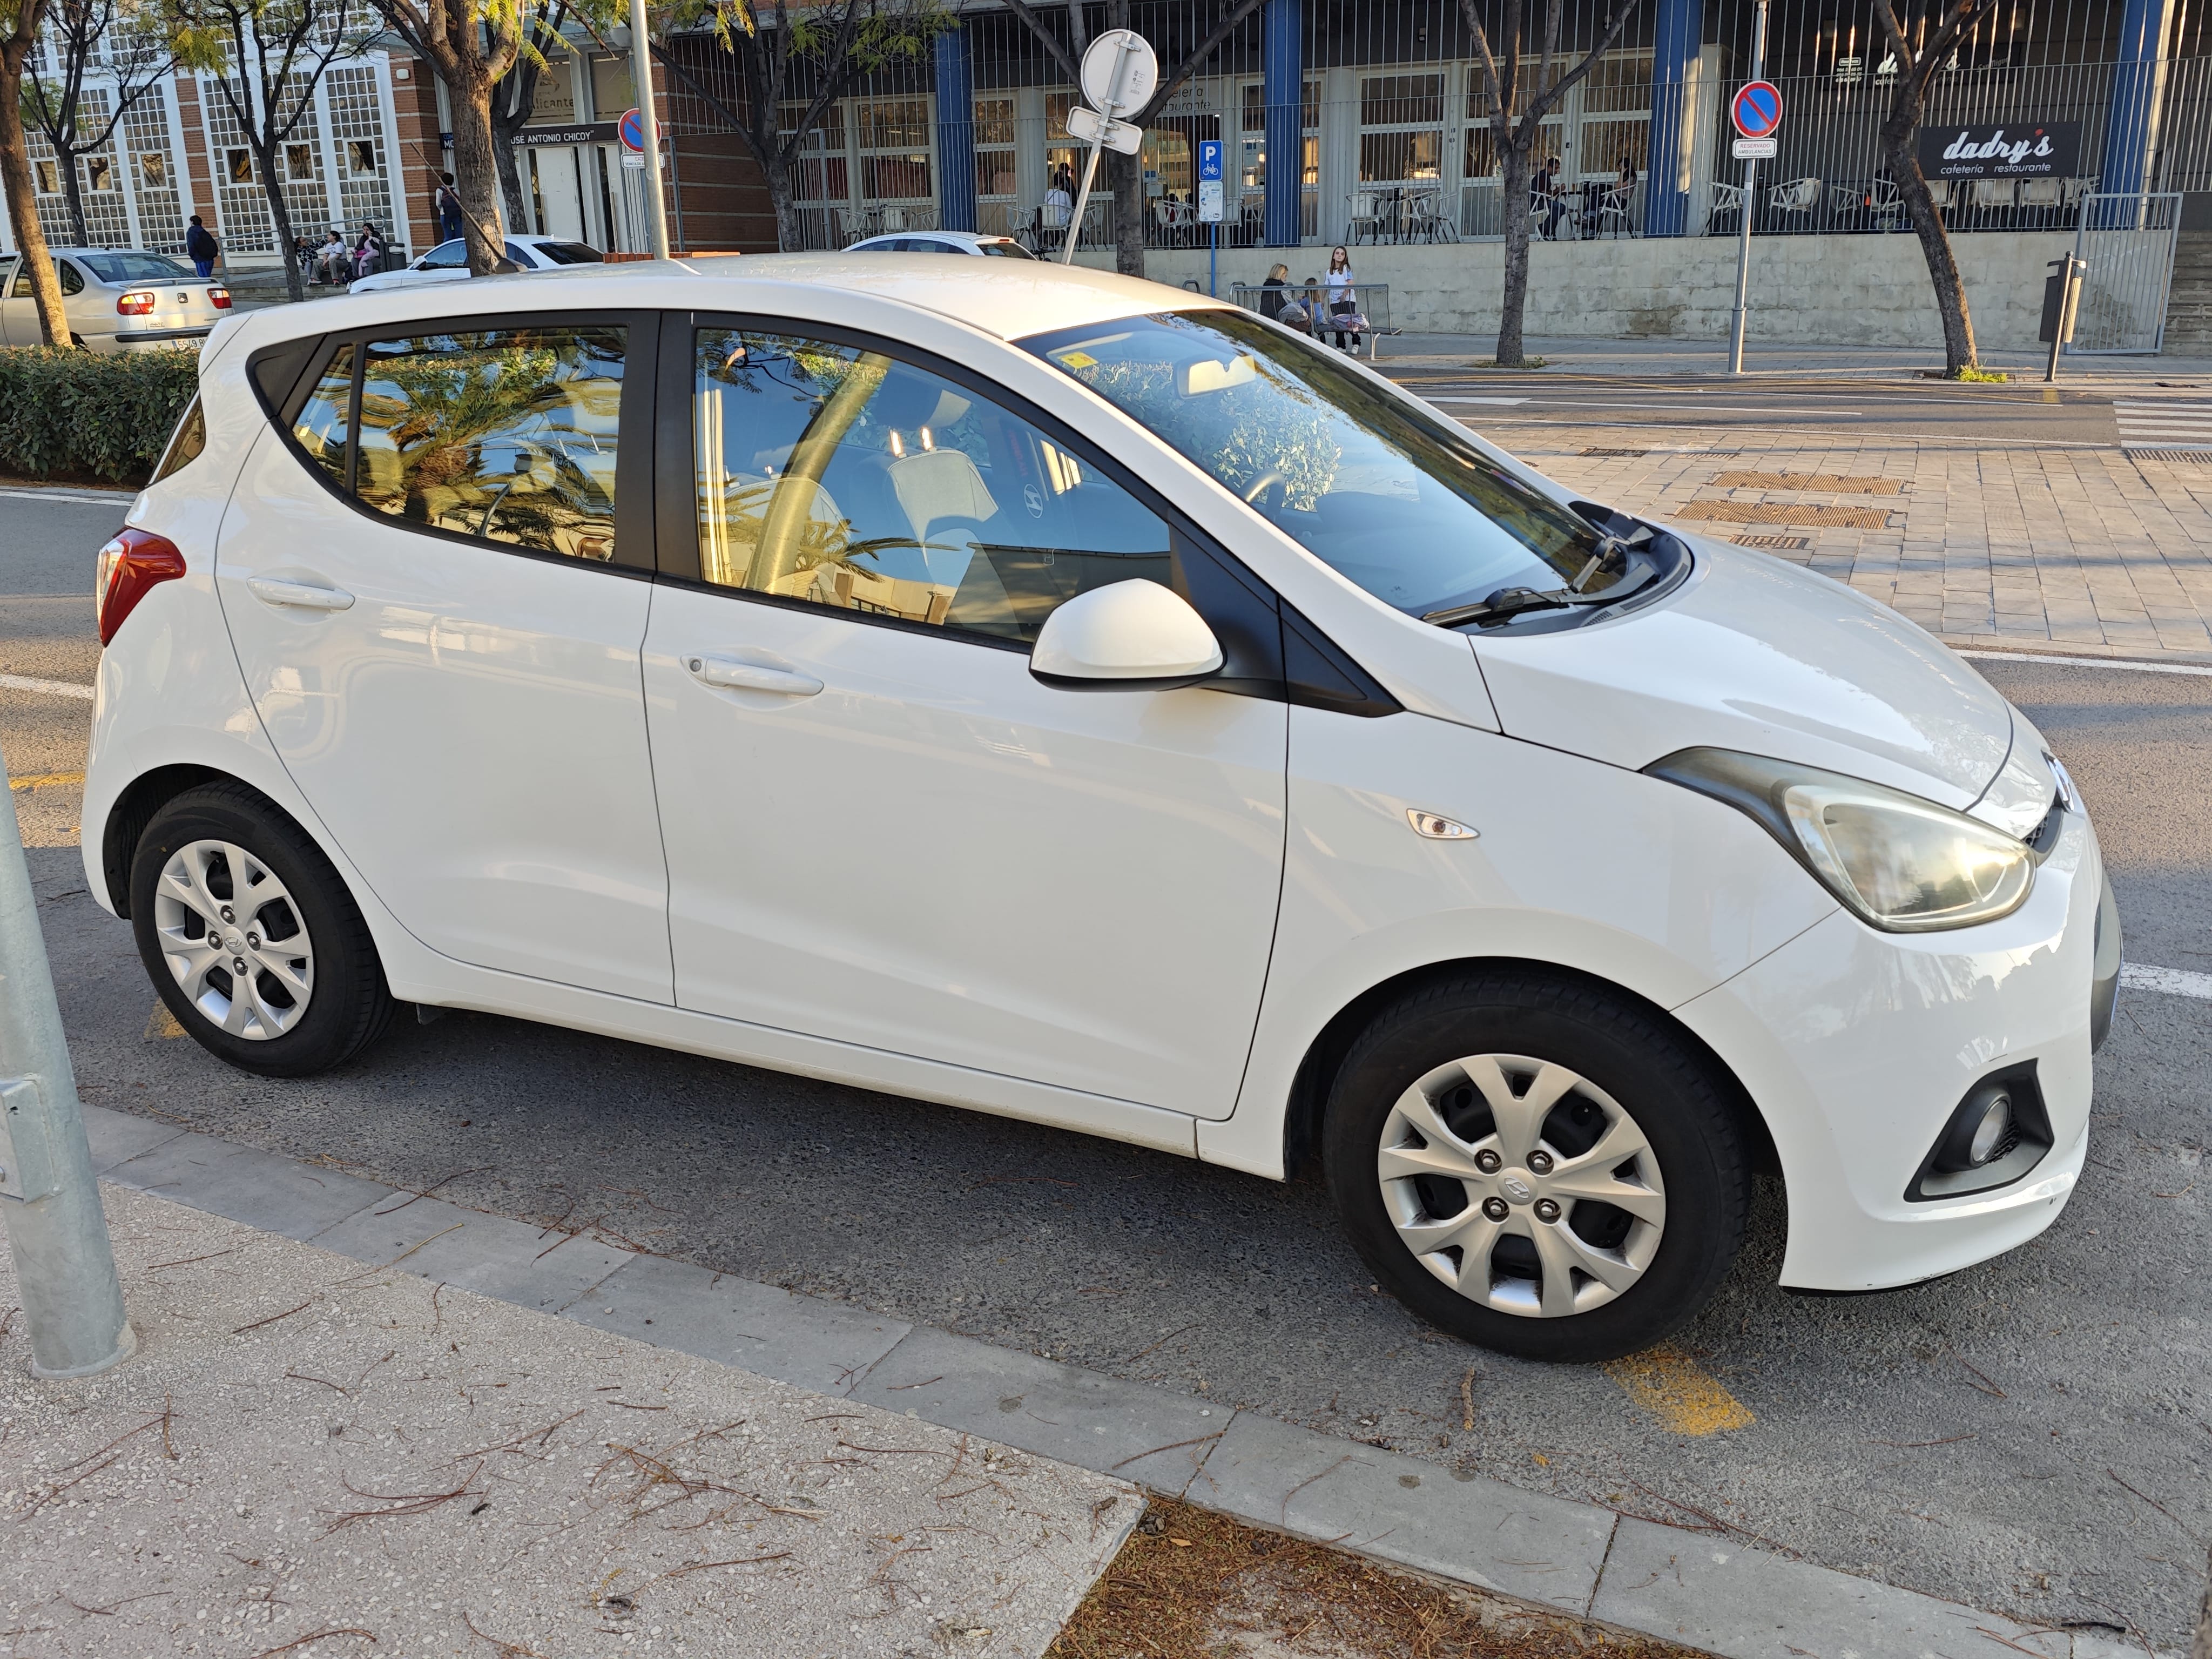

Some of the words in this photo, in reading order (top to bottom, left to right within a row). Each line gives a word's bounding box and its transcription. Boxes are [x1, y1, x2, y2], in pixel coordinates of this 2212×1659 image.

[532, 97, 574, 110] licante
[527, 133, 561, 144] ANTONIO
[1943, 129, 2054, 164] dadry's
[1205, 146, 1216, 161] P
[1940, 163, 1984, 174] cafetería
[1994, 162, 2051, 173] restaurante
[177, 339, 198, 349] 5549
